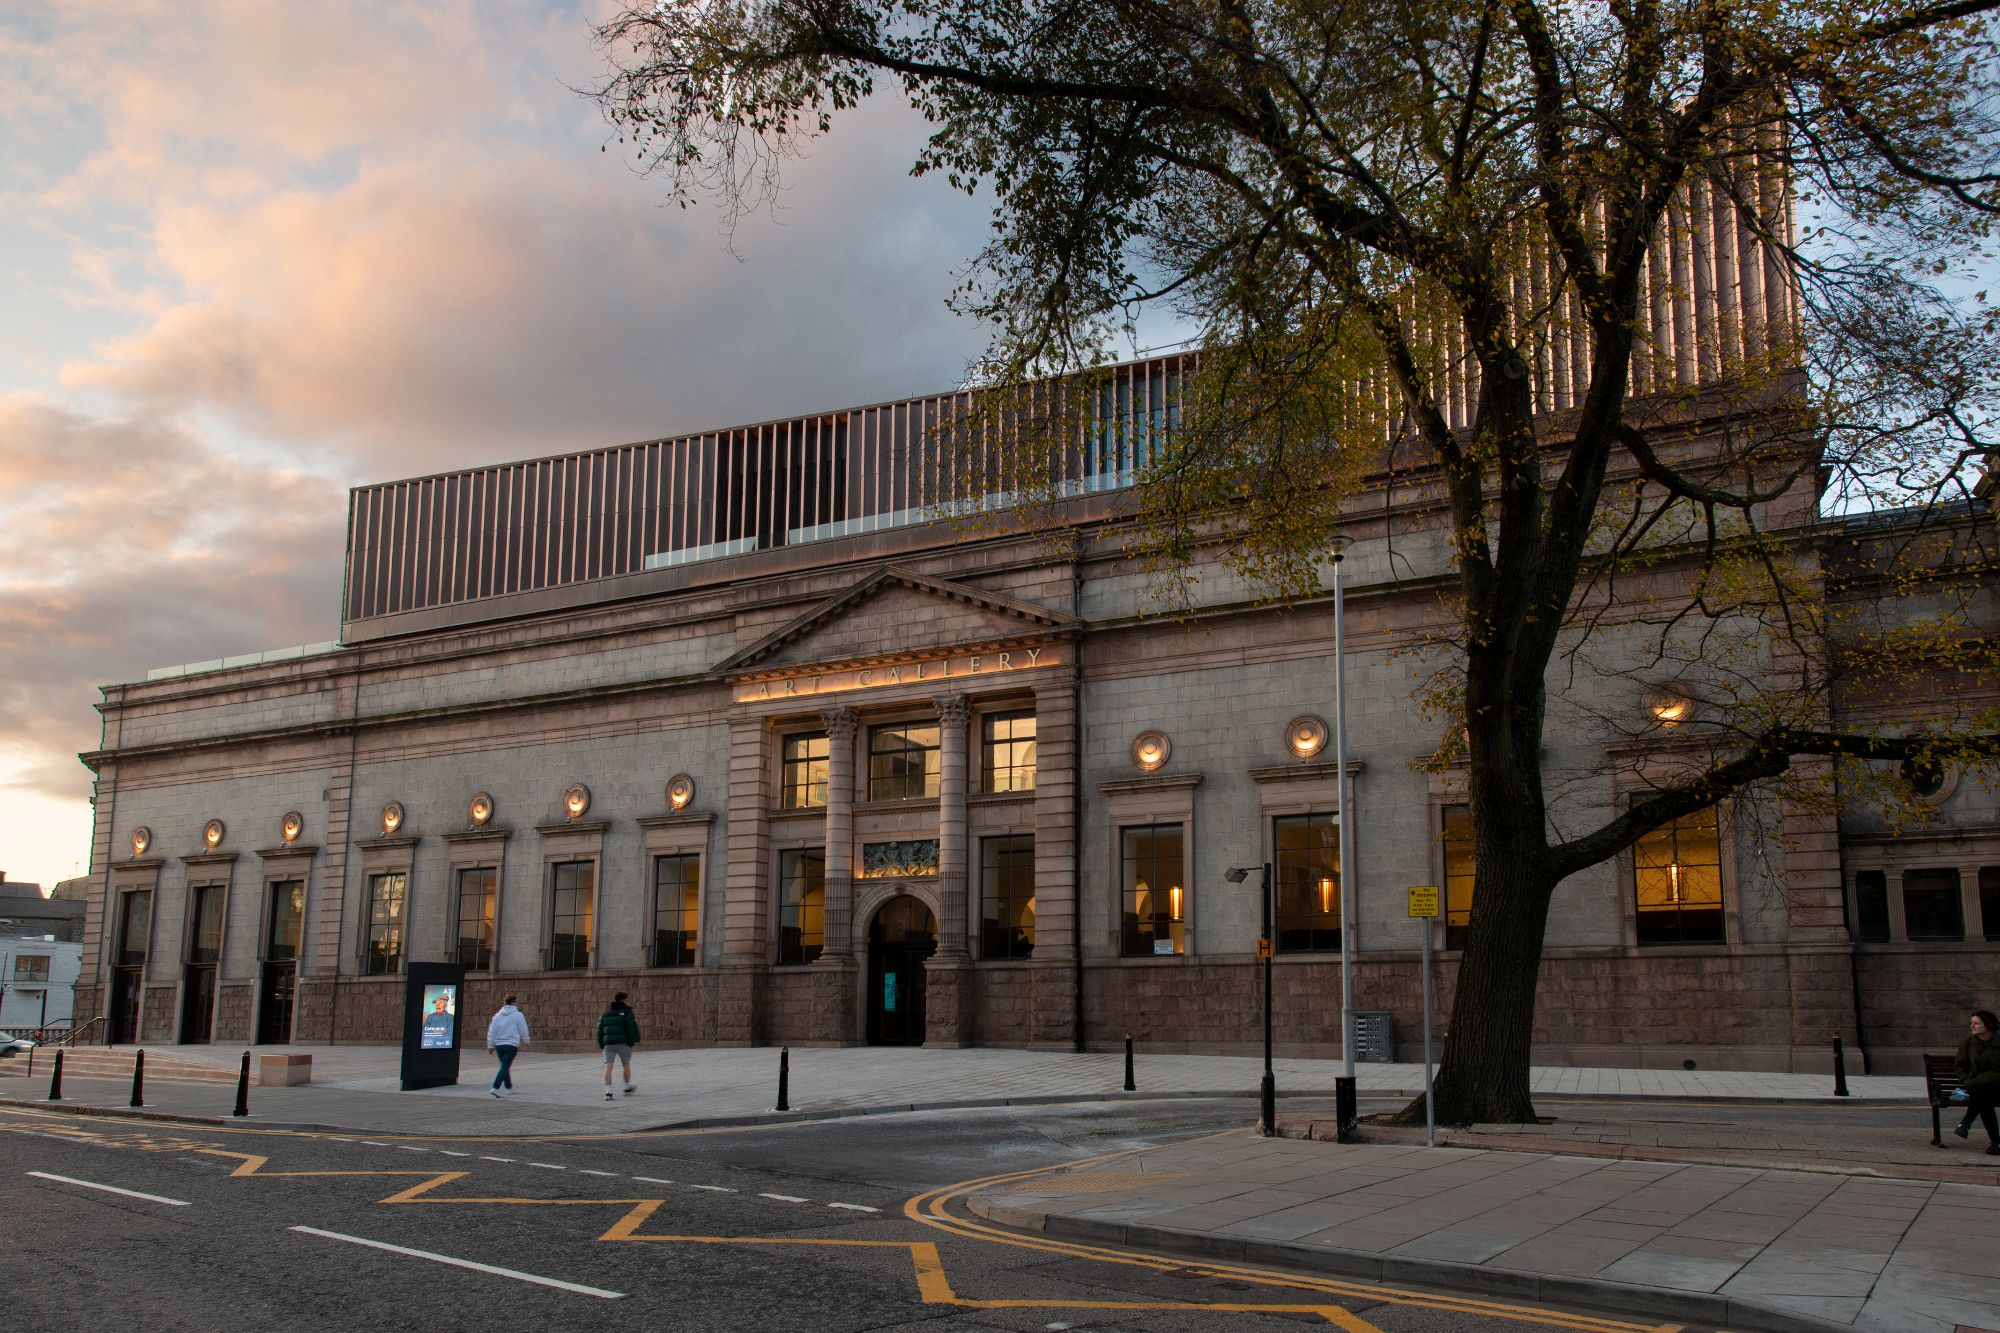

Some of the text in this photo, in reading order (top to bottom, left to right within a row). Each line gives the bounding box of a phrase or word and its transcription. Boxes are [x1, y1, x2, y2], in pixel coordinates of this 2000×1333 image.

[758, 648, 1040, 698] ART GALLERY
[1260, 941, 1270, 955] H
